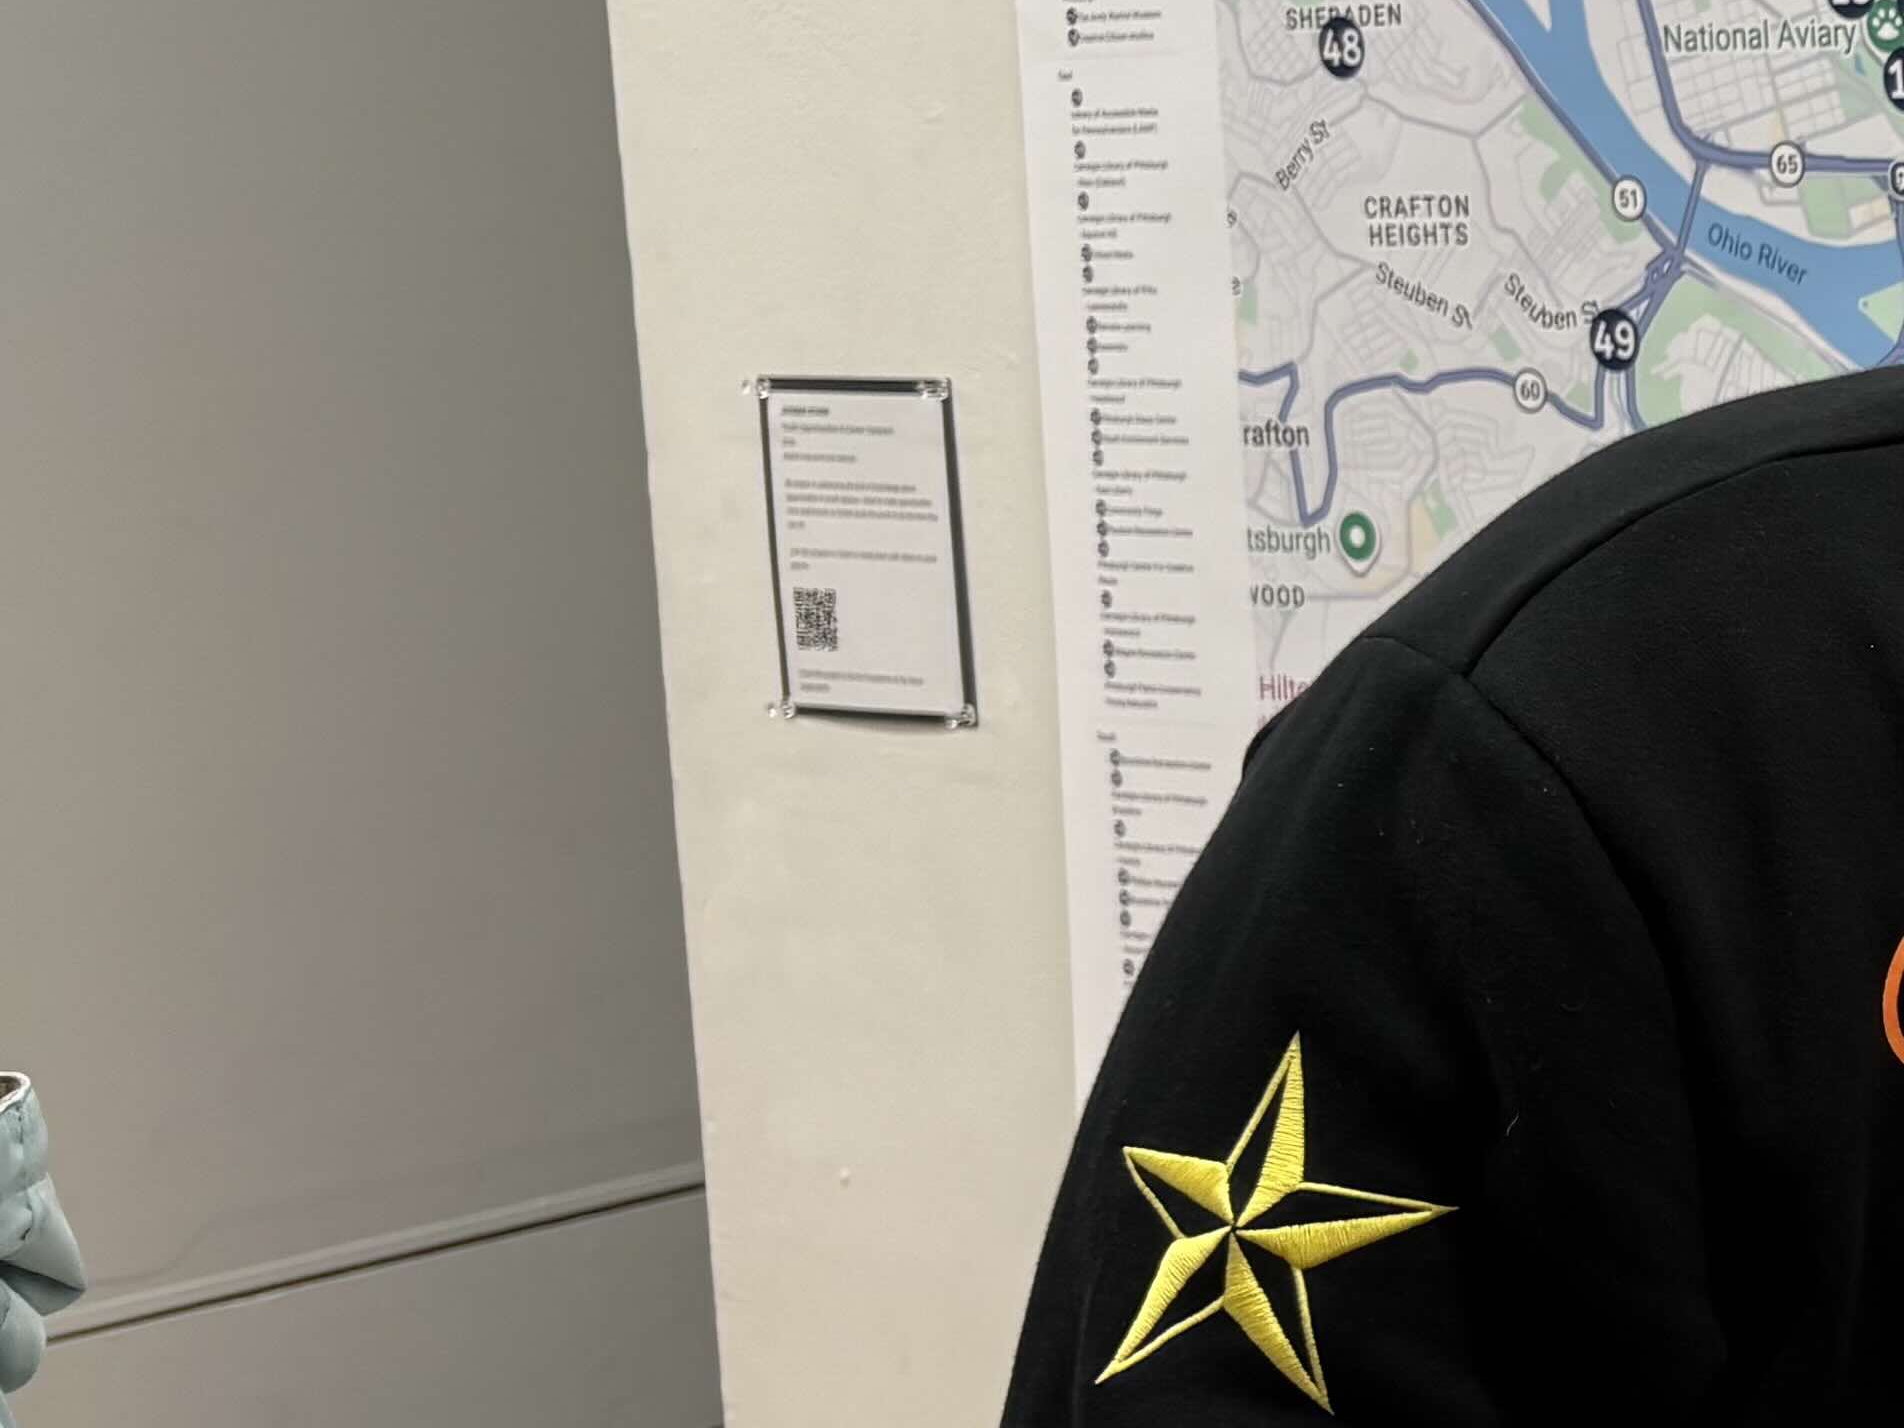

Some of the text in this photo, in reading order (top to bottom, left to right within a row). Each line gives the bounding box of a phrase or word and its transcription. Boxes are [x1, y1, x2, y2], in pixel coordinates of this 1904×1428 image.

[1663, 19, 1857, 58] National Aviary
[1364, 196, 1470, 219] CRAFTON
[1368, 223, 1469, 247] HEIGHTS
